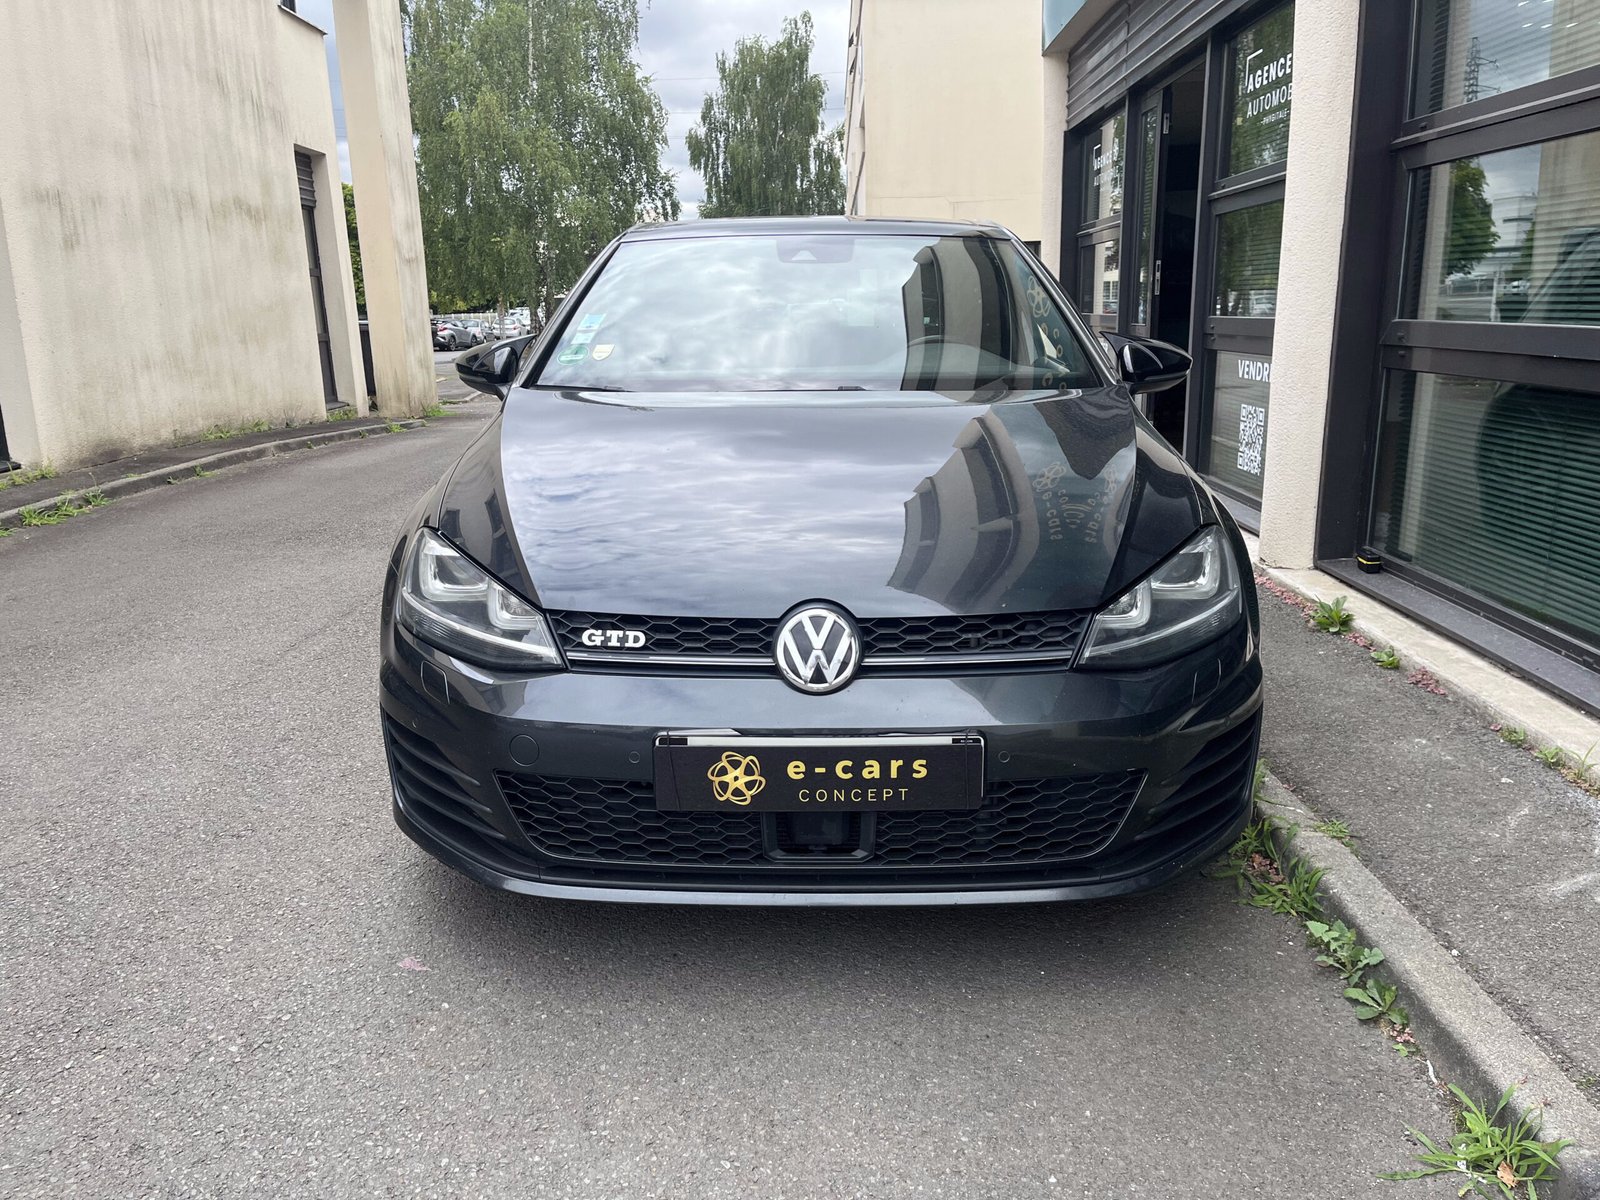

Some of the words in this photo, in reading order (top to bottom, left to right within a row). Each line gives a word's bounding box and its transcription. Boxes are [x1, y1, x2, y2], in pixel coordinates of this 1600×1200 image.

[1247, 53, 1292, 93] AGENCE
[581, 629, 646, 648] GTD
[786, 759, 928, 780] e-cars
[798, 788, 909, 802] CONCEPT
